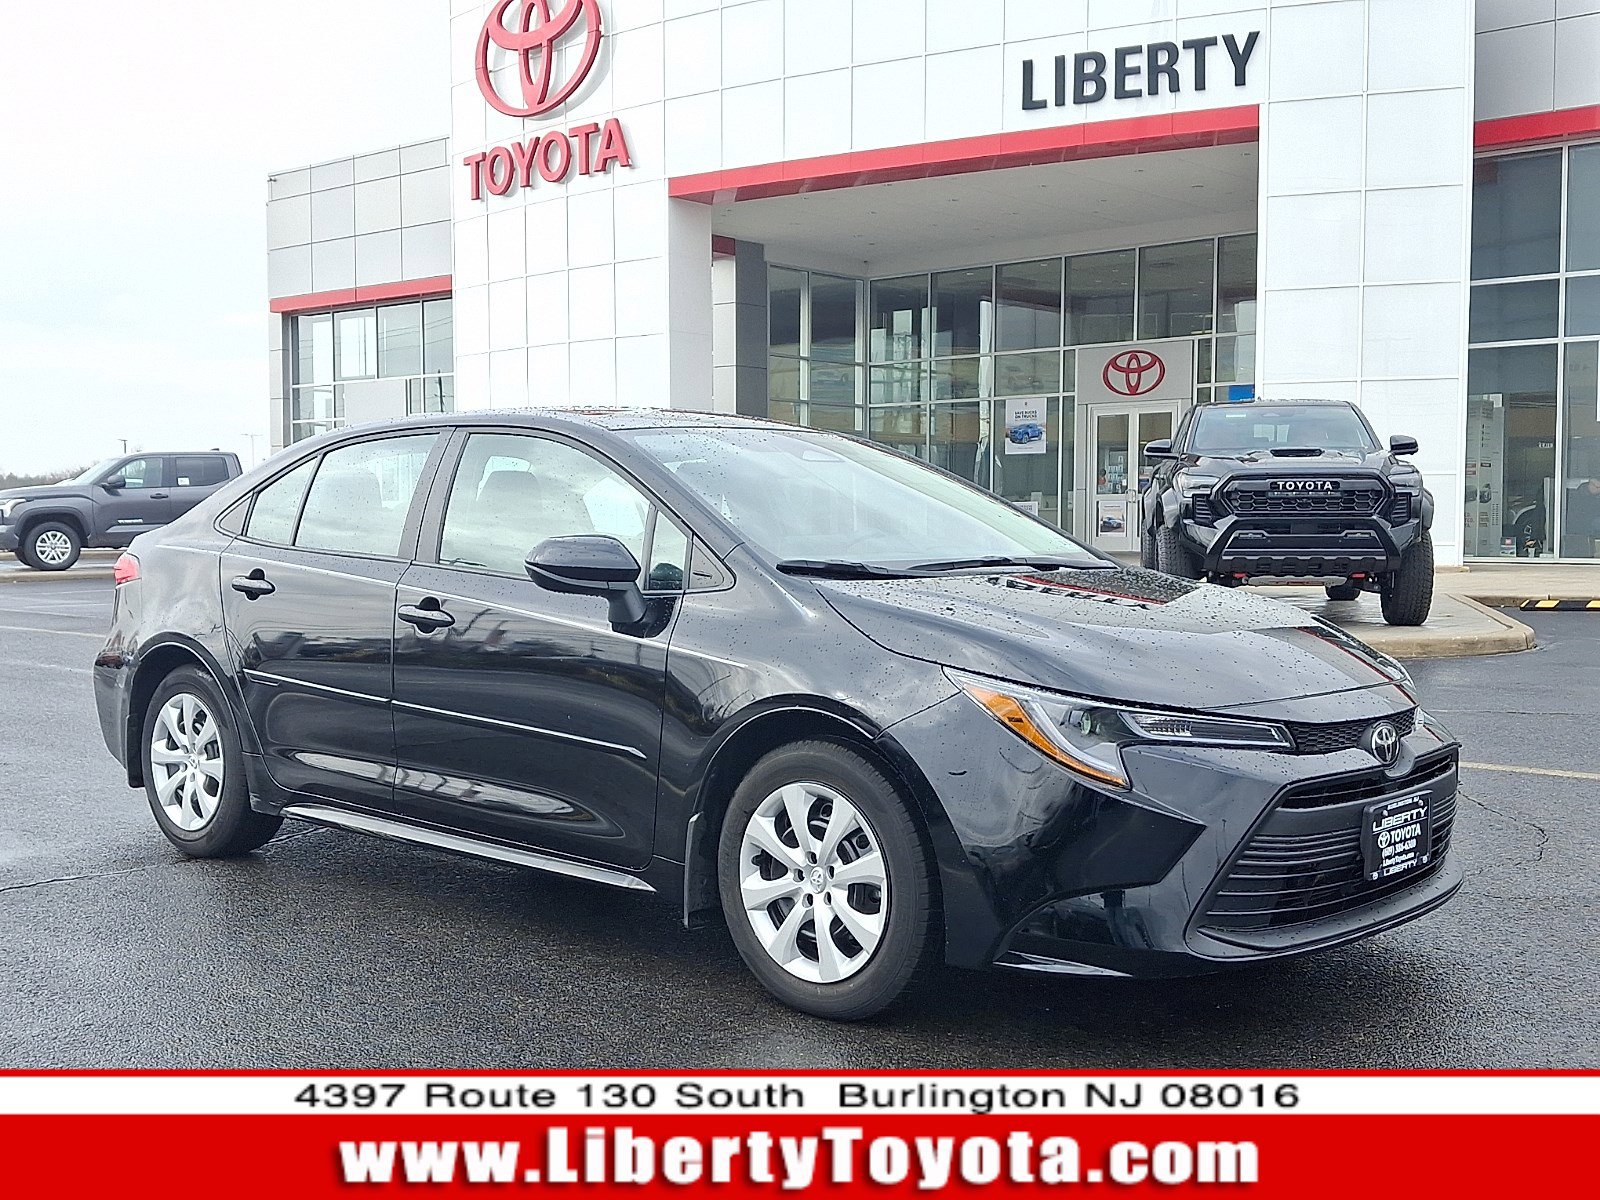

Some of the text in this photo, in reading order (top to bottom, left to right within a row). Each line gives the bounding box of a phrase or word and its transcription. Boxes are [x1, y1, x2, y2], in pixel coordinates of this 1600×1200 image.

[1022, 31, 1260, 110] LIBERTY
[463, 118, 632, 200] TOYOTA
[1277, 481, 1333, 491] TOYOTA
[1372, 806, 1428, 832] LIBERTY
[1390, 823, 1422, 843] TOYOTA
